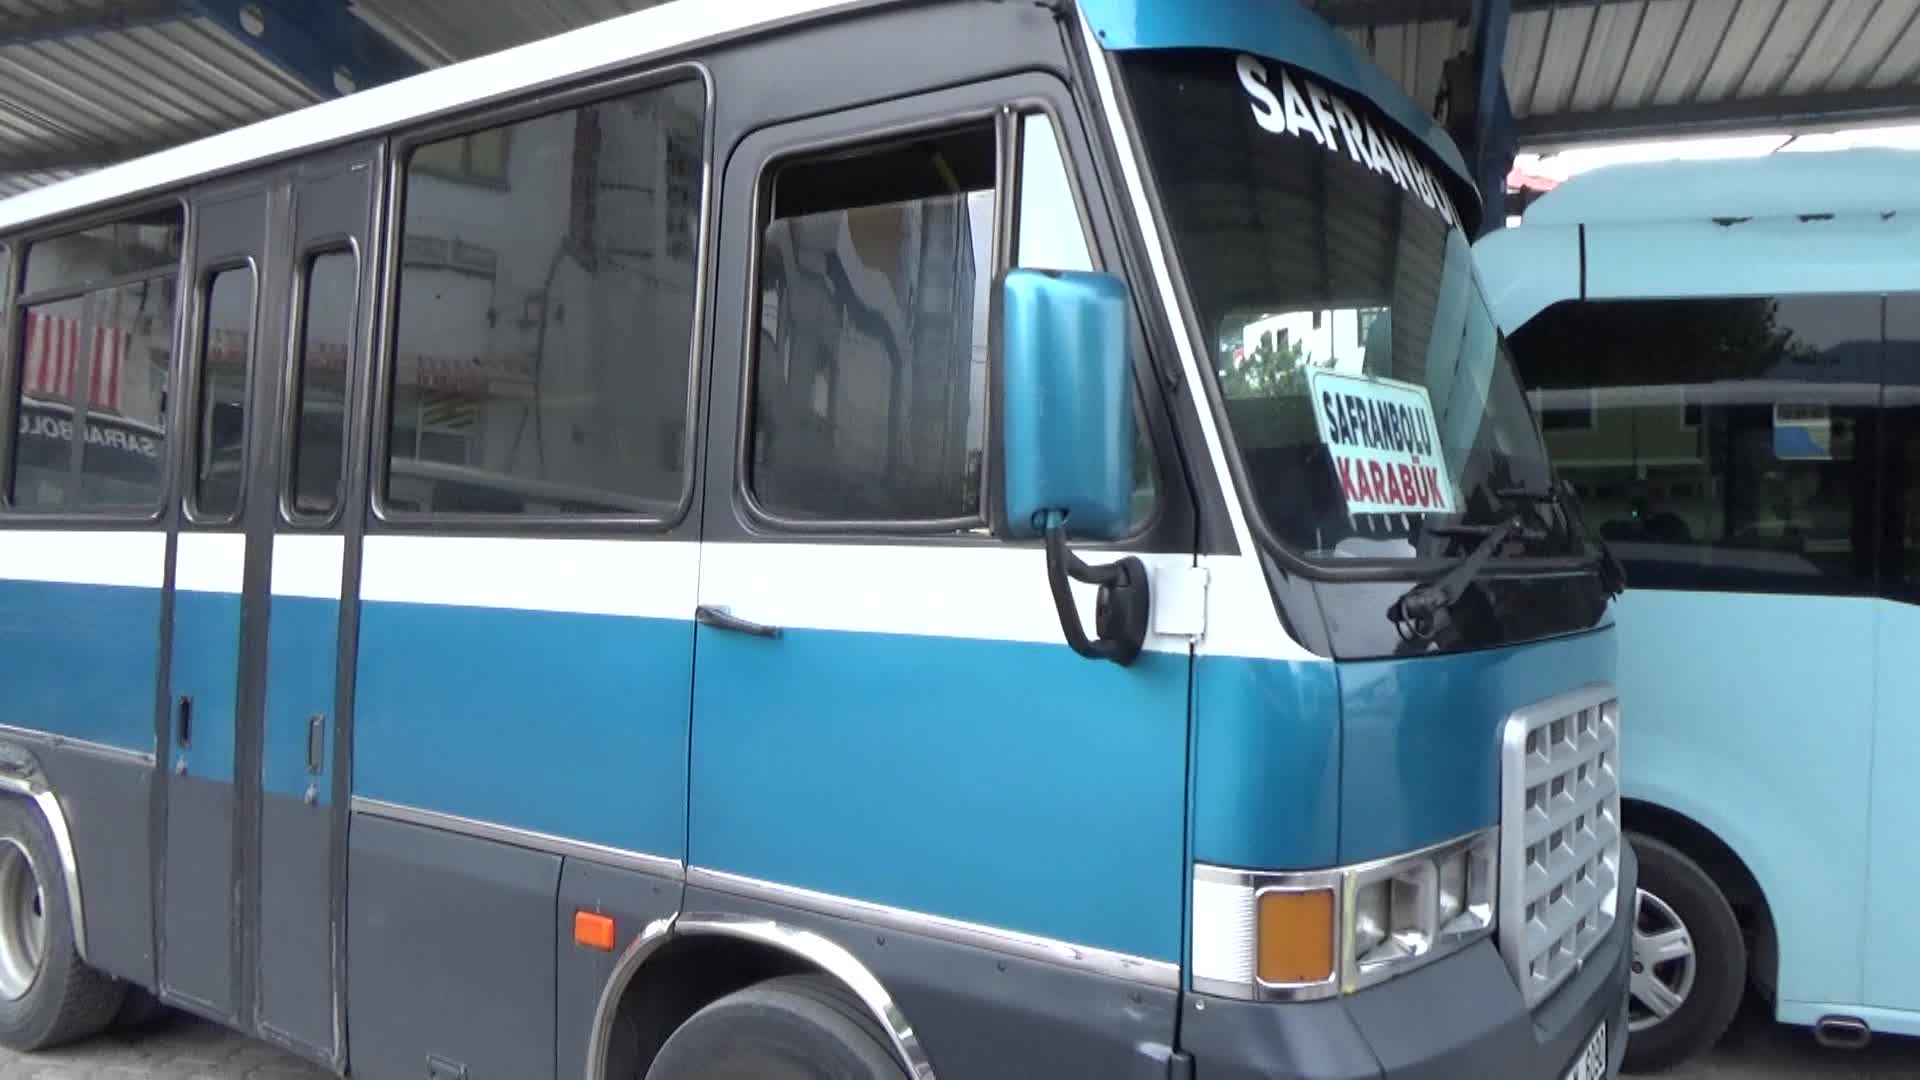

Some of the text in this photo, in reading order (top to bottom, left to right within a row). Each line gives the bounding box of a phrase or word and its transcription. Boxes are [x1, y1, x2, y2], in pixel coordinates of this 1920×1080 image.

[1236, 54, 1462, 233] SAFRANBO
[1323, 391, 1432, 457] SAFRANBOLU
[1337, 454, 1445, 508] KARABÜK
